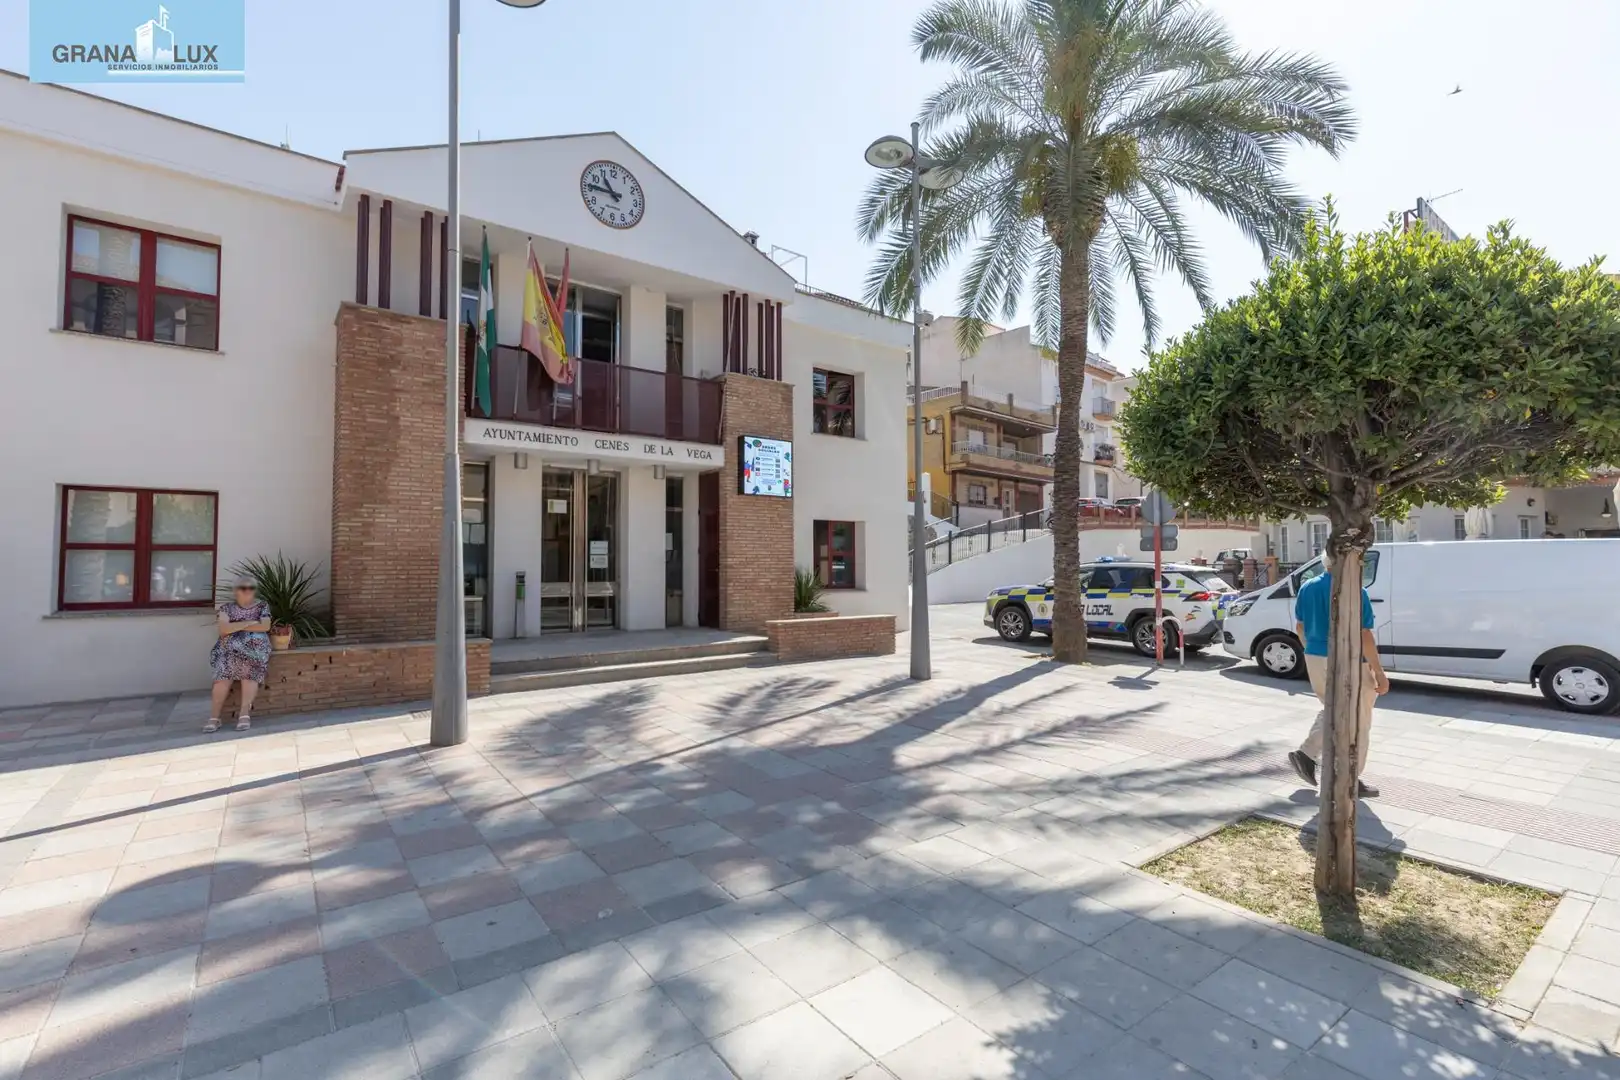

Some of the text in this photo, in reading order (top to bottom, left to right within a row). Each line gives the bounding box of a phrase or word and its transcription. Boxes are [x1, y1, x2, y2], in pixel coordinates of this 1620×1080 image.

[609, 169, 618, 179] 12
[592, 174, 600, 184] 10
[622, 176, 626, 184] 1
[630, 186, 635, 195] 2
[591, 196, 597, 205] 8
[632, 199, 638, 208] 3
[600, 207, 605, 215] 7
[628, 209, 634, 217] 4
[610, 212, 615, 221] 6
[620, 213, 626, 222] 5
[483, 427, 713, 460] AYUNTAMIENTO CENES DE LA VEGA
[1086, 604, 1114, 616] LOCAL
